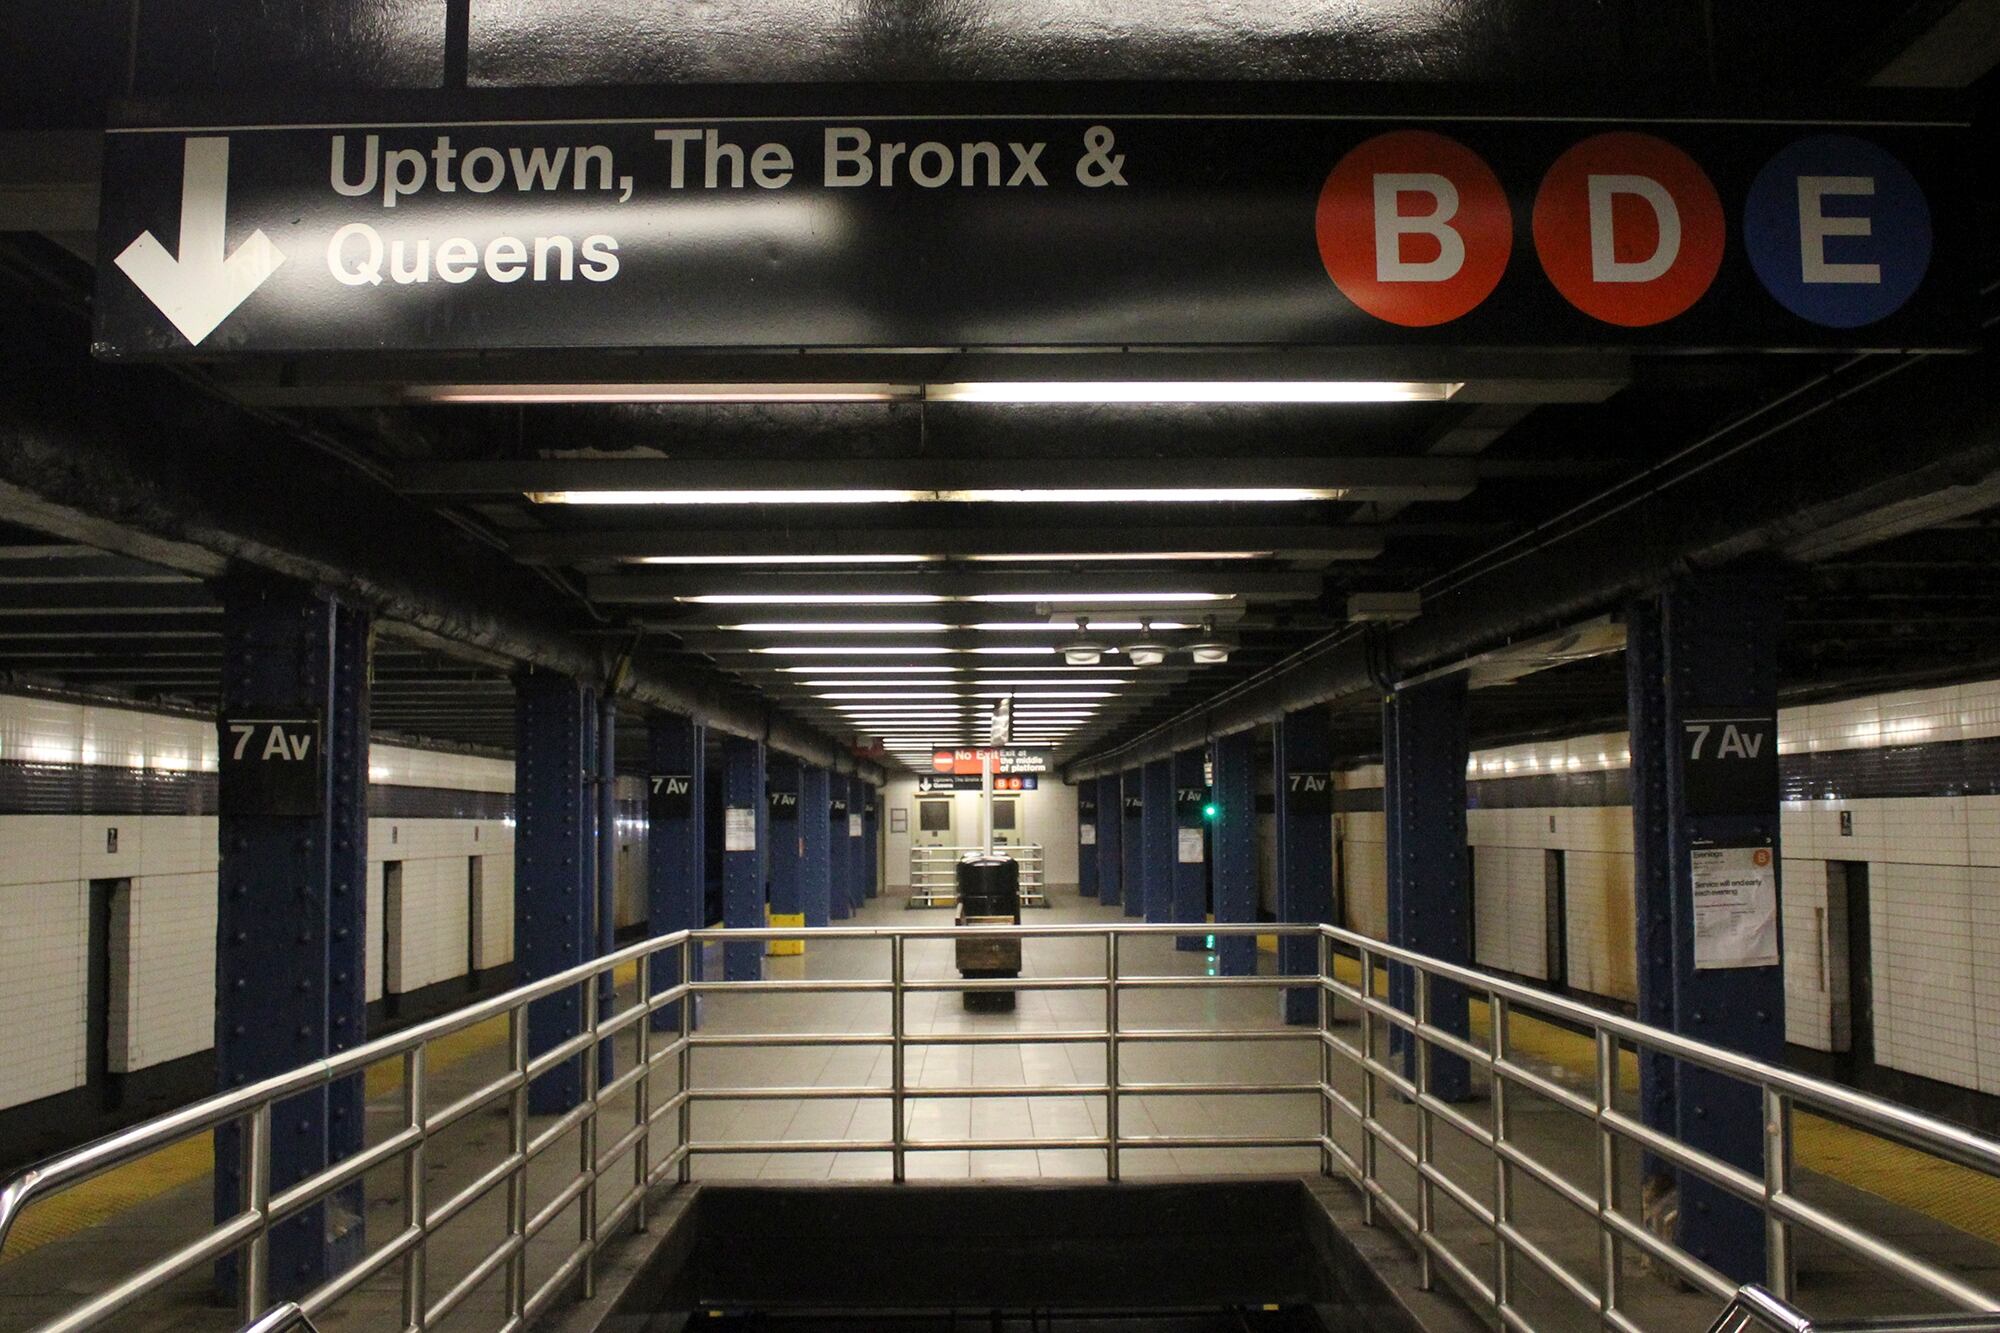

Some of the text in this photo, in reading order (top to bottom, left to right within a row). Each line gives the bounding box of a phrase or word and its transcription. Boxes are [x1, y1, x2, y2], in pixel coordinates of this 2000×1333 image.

[330, 125, 1129, 208] Uptown, The Bronx &
[1372, 172, 1882, 285] B D E
[326, 222, 620, 287] Queens
[229, 724, 312, 761] 7 Av
[955, 750, 972, 760] No
[1685, 723, 1764, 760] 7 Av
[651, 778, 689, 795] 7 Av
[1178, 790, 1186, 801] 7
[1289, 775, 1327, 791] 7 Av
[781, 793, 797, 805] Av
